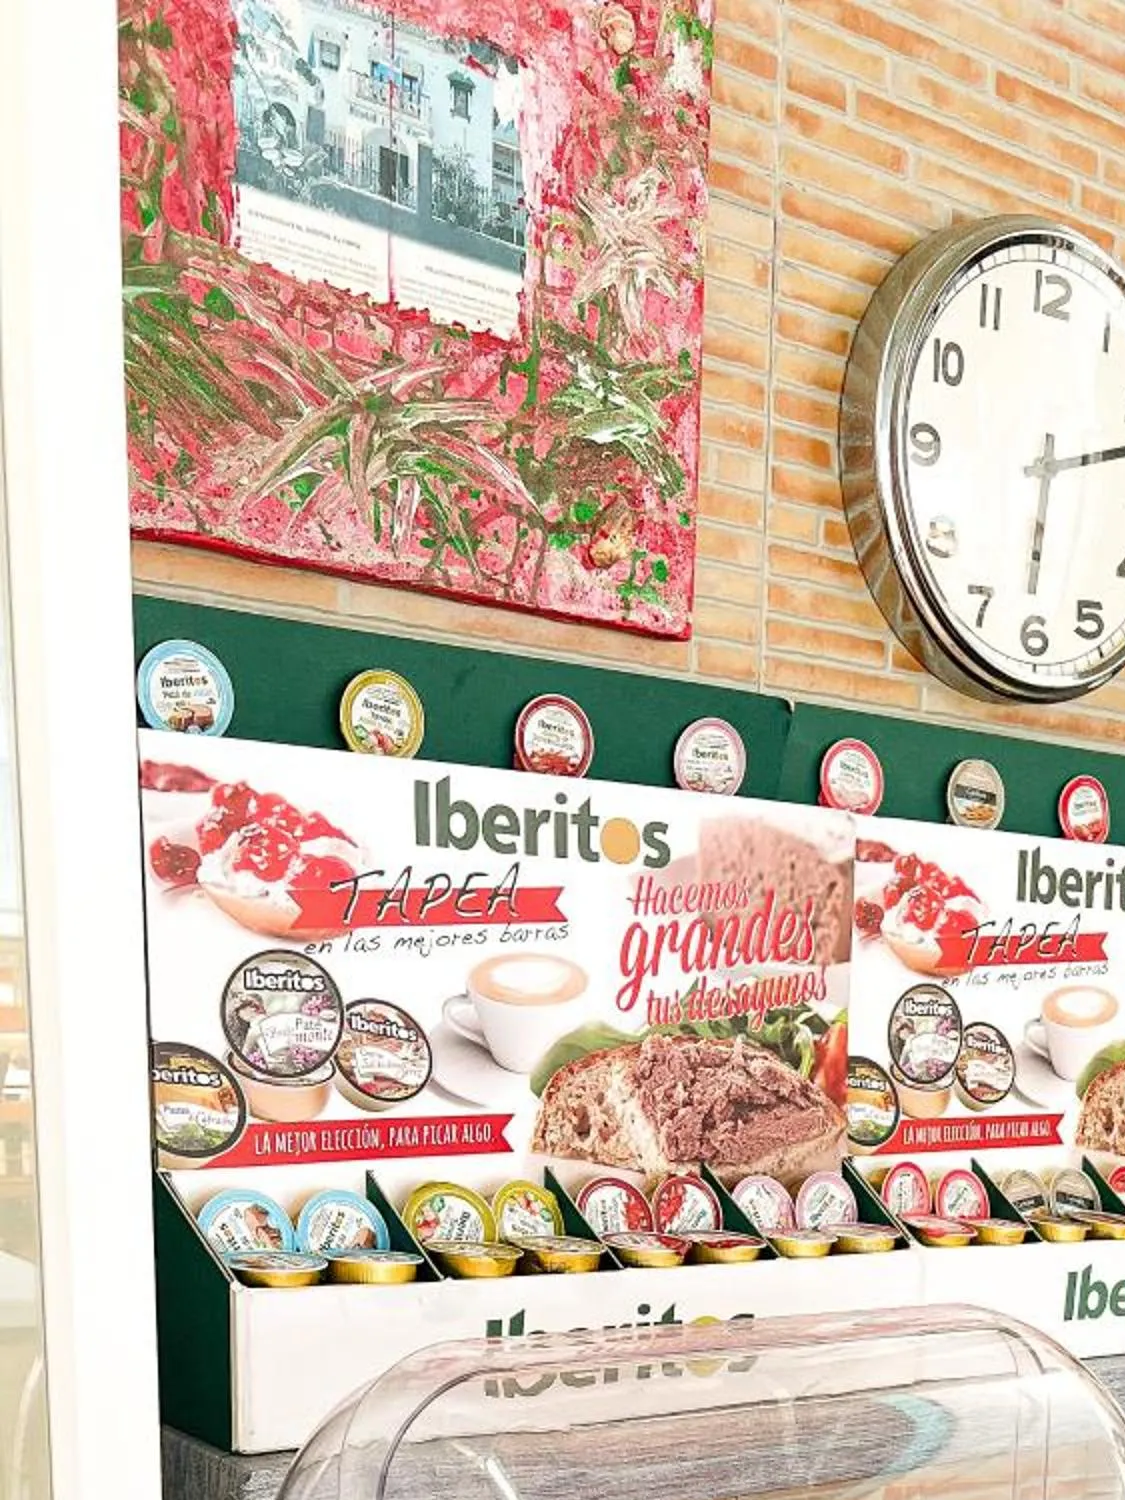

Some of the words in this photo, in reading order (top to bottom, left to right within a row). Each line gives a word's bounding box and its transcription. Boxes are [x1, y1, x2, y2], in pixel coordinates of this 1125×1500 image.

[980, 283, 1002, 331] 11
[1033, 269, 1073, 322] 12
[1102, 313, 1111, 353] 1
[933, 337, 964, 387] 10
[910, 422, 941, 467] 9
[926, 516, 958, 559] 8
[968, 584, 994, 628] 7
[1074, 599, 1105, 641] 5
[1020, 615, 1049, 657] 6
[413, 775, 671, 869] Iberitos
[329, 862, 521, 925] TAPEA
[626, 875, 751, 916] Hacemos
[304, 940, 333, 955] en
[345, 931, 382, 952] las
[393, 928, 488, 958] mejores
[499, 922, 570, 944] barras
[615, 886, 815, 1013] grandes
[961, 913, 1082, 964] TAPEA
[243, 967, 326, 992] Iberitos
[942, 974, 960, 988] en
[966, 970, 989, 986] las
[997, 967, 1058, 991] mejores
[1064, 962, 1109, 979] barras
[646, 989, 682, 1026] tus
[687, 964, 828, 1033] desayunos
[903, 998, 953, 1017] Iberitos
[350, 1013, 418, 1042] Iberitos
[254, 1131, 271, 1156] LA
[275, 1131, 318, 1157] MEJOR
[321, 1123, 385, 1151] ELECCIÓN,
[389, 1125, 419, 1148] PARA
[422, 1123, 458, 1146] PICAR
[461, 1123, 496, 1144] ALGO.
[903, 1125, 914, 1145] LA
[915, 1124, 942, 1146] MEJOR
[985, 1122, 1005, 1140] PARA
